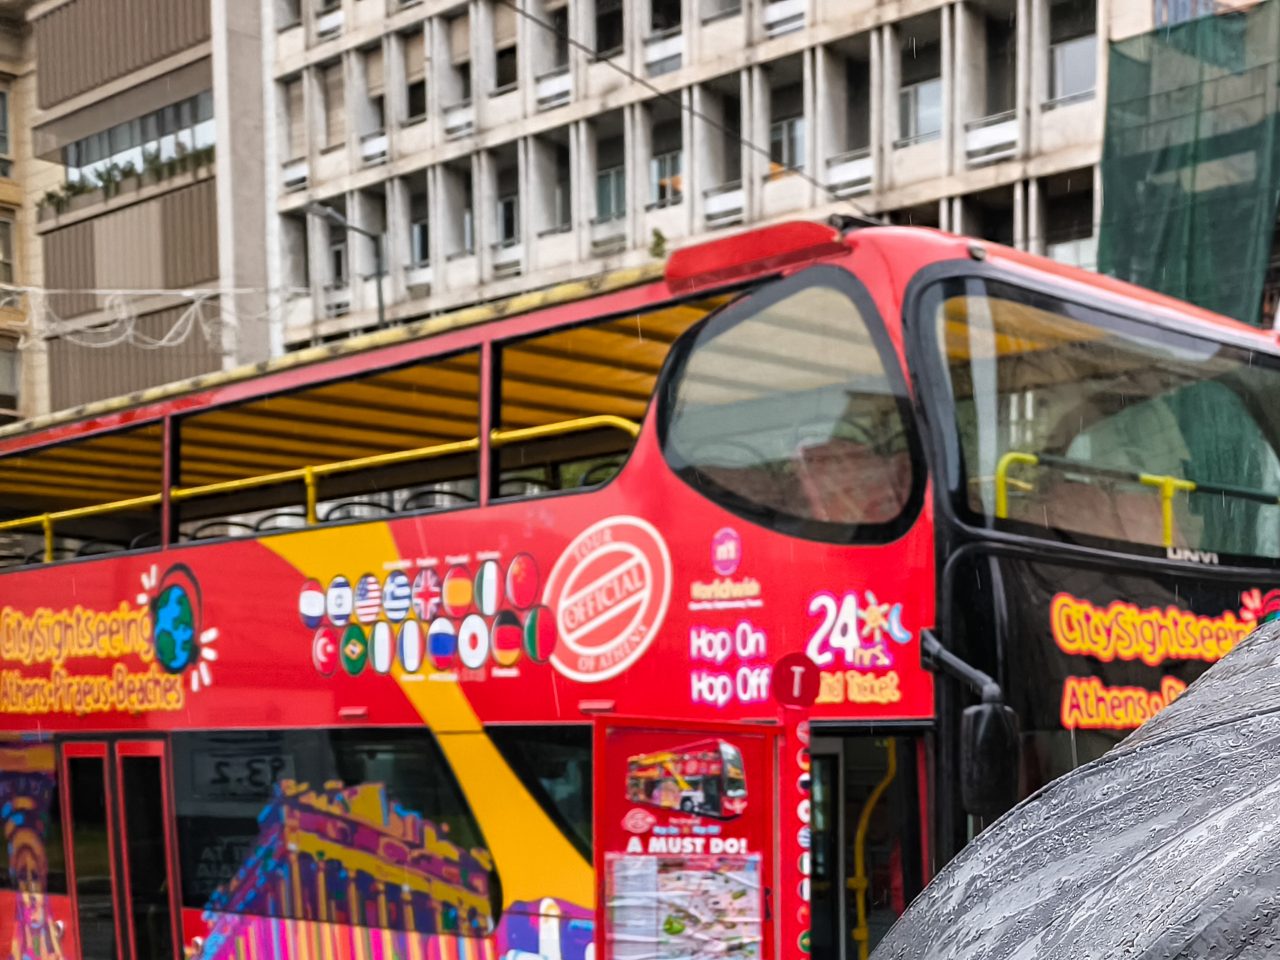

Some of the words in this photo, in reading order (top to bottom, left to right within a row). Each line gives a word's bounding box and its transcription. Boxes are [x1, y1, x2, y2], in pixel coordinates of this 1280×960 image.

[1167, 547, 1219, 565] UNVI
[564, 562, 643, 629] OFFICIAL
[689, 627, 731, 663] Hop
[735, 622, 767, 659] On
[806, 594, 861, 665] 24
[690, 671, 732, 707] Hop
[736, 666, 772, 702] Off
[626, 836, 643, 853] A
[648, 836, 706, 854] MUST
[709, 837, 748, 854] DO!
